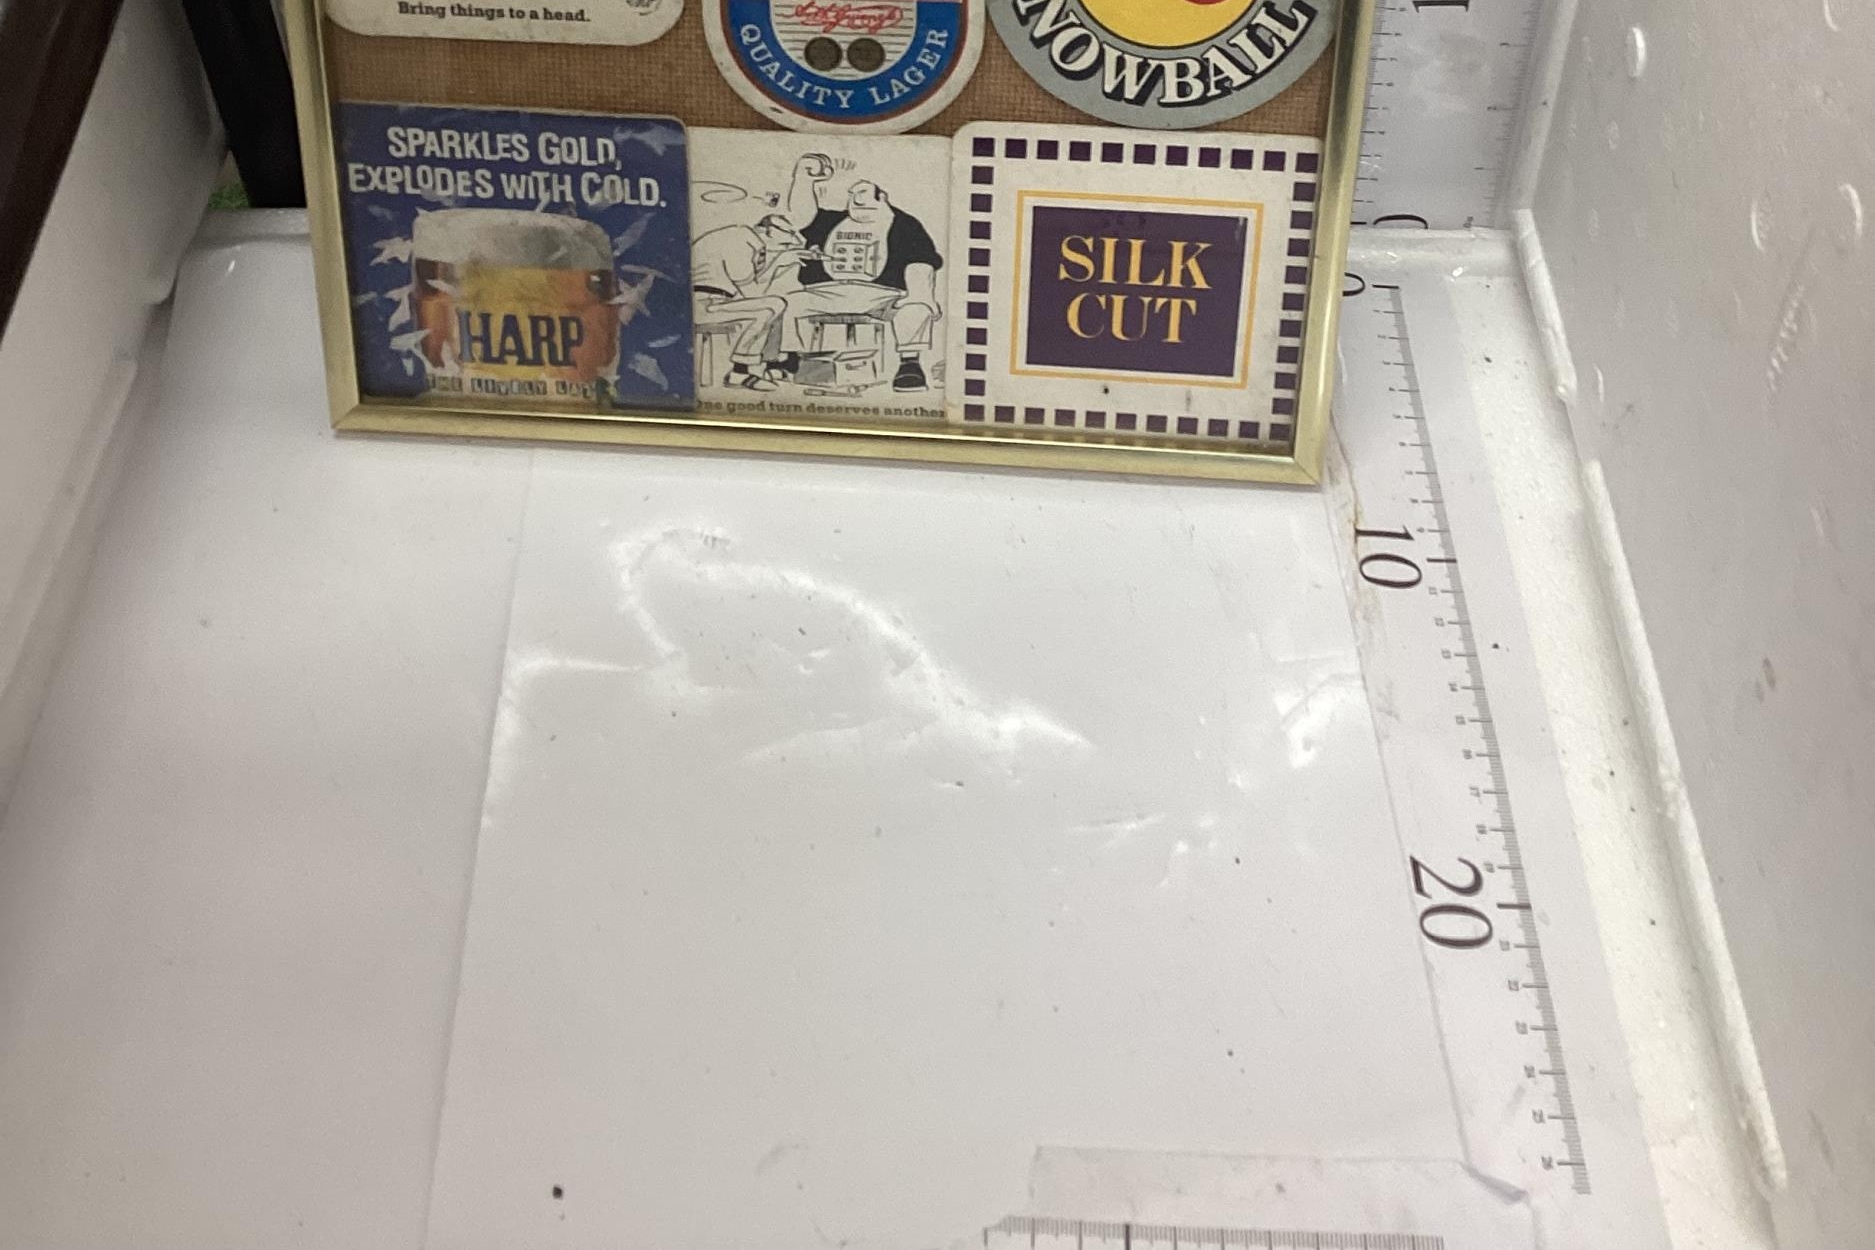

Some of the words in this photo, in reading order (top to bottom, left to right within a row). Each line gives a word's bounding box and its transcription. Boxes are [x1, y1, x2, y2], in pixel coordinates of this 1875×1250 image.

[398, 1, 446, 18] Bring
[450, 3, 505, 21] things
[509, 5, 526, 19] to
[530, 8, 540, 21] a
[544, 6, 591, 23] head.
[740, 23, 853, 110] QUALITY
[869, 28, 949, 106] LAGER
[387, 126, 528, 163] SPARKLES
[538, 131, 623, 171] GOLD,
[348, 163, 494, 199] EXPLODES
[502, 170, 573, 203] WITH
[581, 172, 667, 208] COLD.
[1058, 235, 1213, 290] SILK
[459, 308, 585, 367] HARP
[1066, 292, 1198, 344] CUT
[727, 401, 765, 414] good
[769, 402, 801, 414] turn
[806, 402, 879, 417] deserves
[1355, 525, 1424, 589] 10
[1410, 855, 1493, 949] 20
